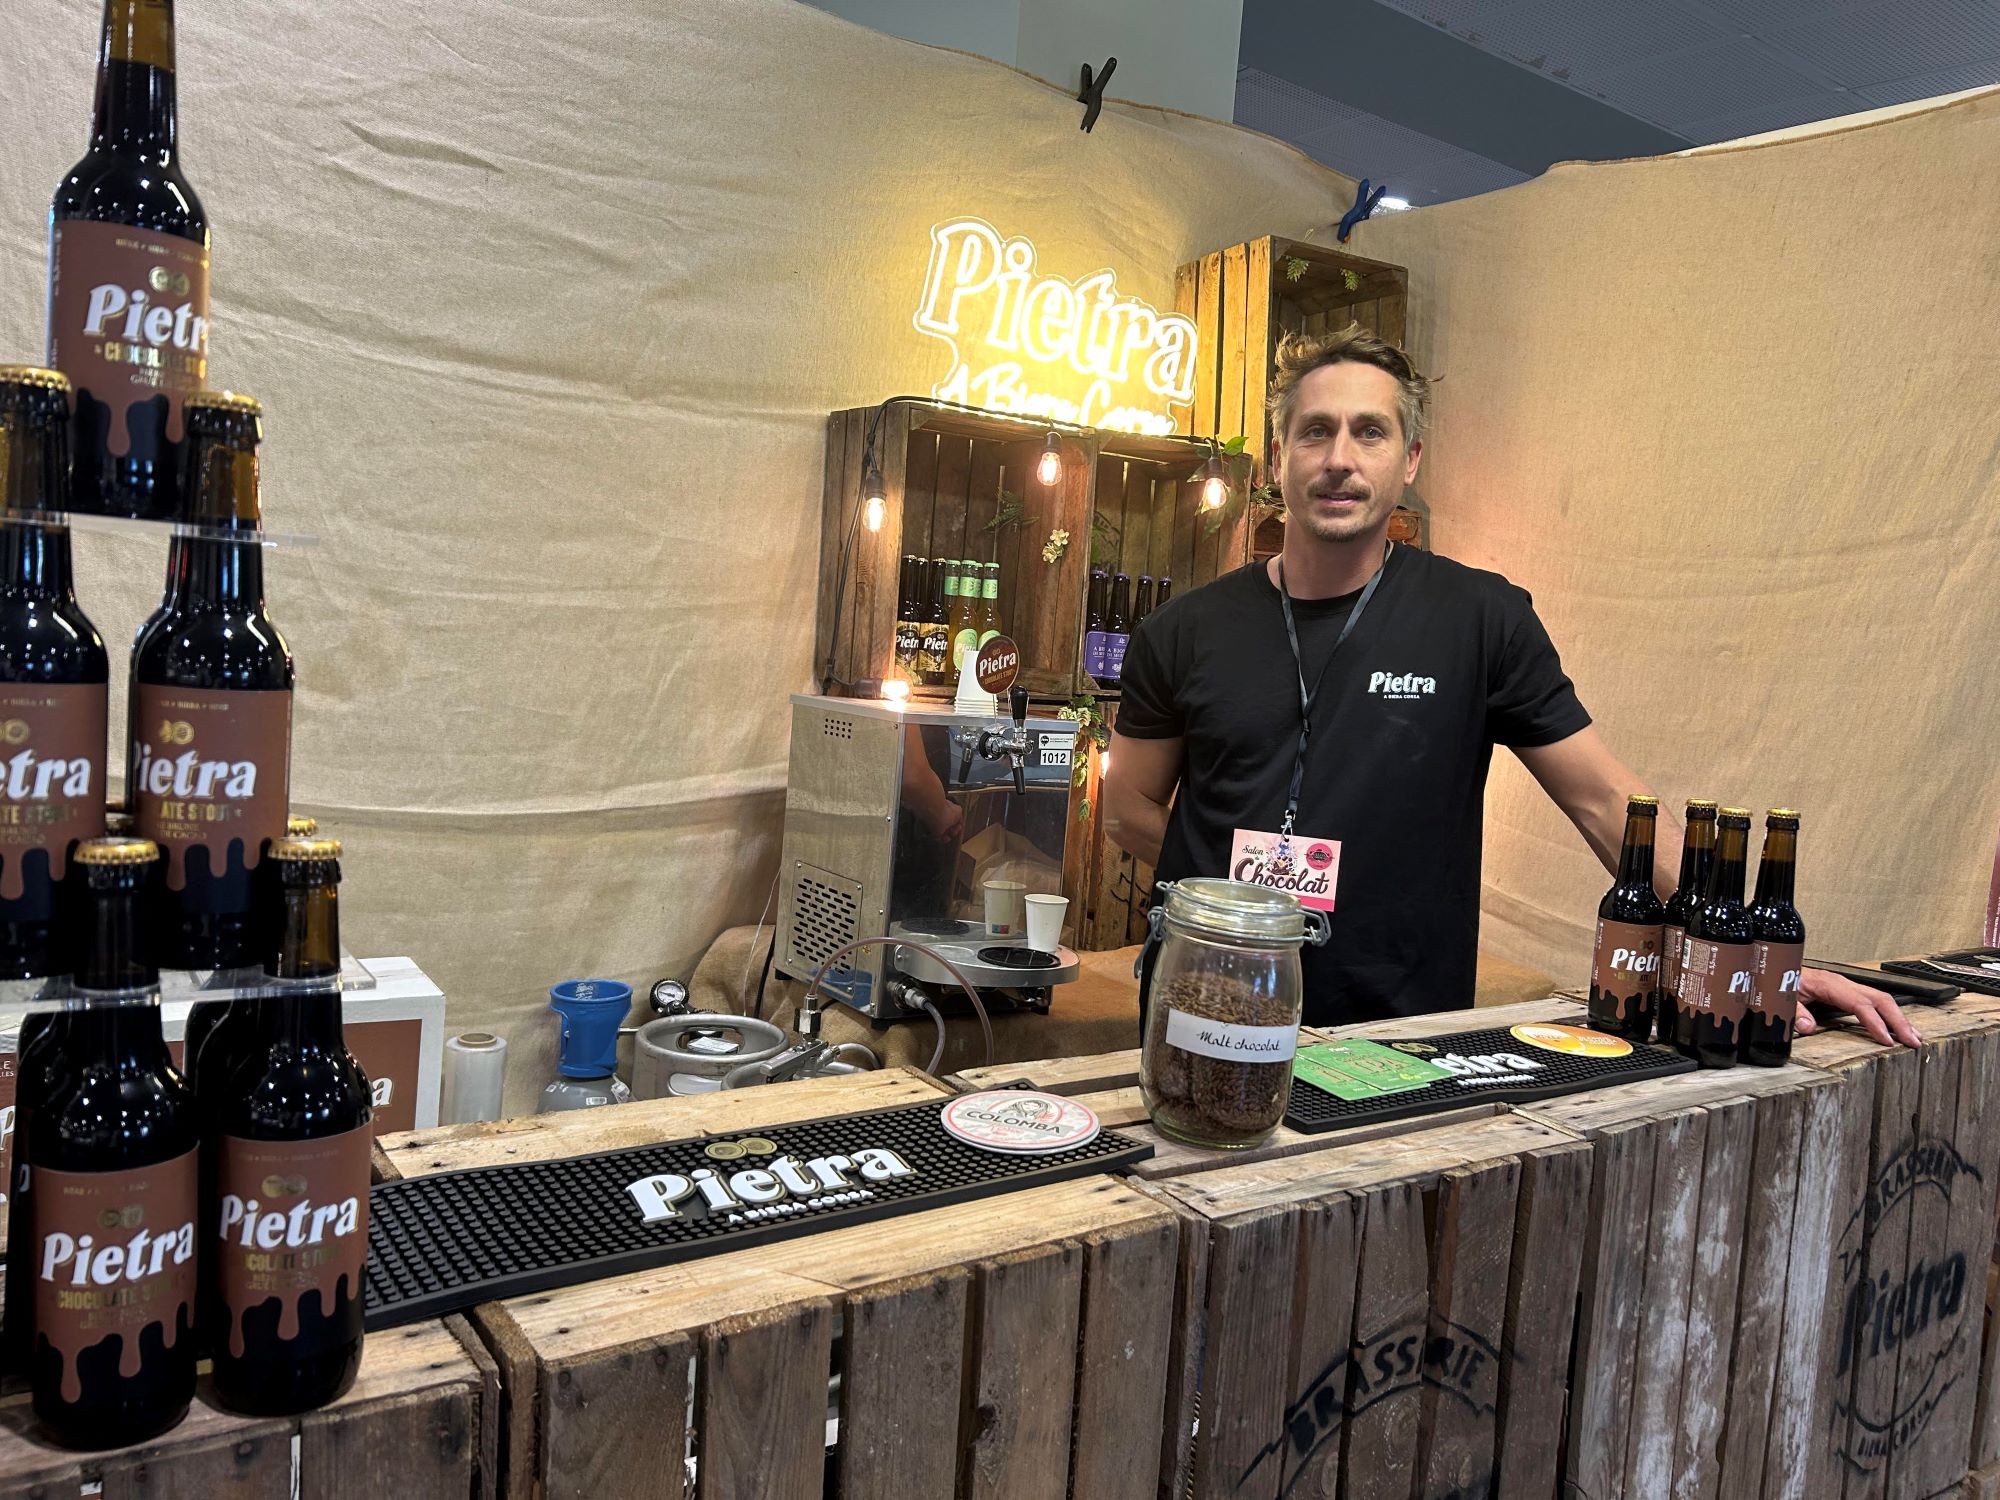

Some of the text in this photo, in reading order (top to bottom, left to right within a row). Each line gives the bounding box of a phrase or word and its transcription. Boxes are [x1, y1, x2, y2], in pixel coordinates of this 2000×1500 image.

[83, 283, 209, 352] Pietr
[919, 221, 1198, 400] Pietra
[896, 634, 919, 649] Pietr
[923, 636, 948, 650] Pietr
[979, 652, 1017, 678] Pietra
[1367, 671, 1437, 694] Pietra
[1042, 752, 1067, 764] 1012
[1241, 844, 1264, 856] Salon
[1234, 857, 1330, 895] Chocolat
[1610, 948, 1661, 972] Pietr
[1196, 1030, 1281, 1052] Malt chocolat
[966, 1110, 1061, 1134] COLOMBA
[625, 1146, 915, 1223] Pietra
[728, 1213, 743, 1224] A
[808, 1189, 875, 1211] CORSA
[219, 1194, 359, 1249] Pietra
[41, 1221, 194, 1287] Pietra
[1836, 1252, 1967, 1379] Pietra
